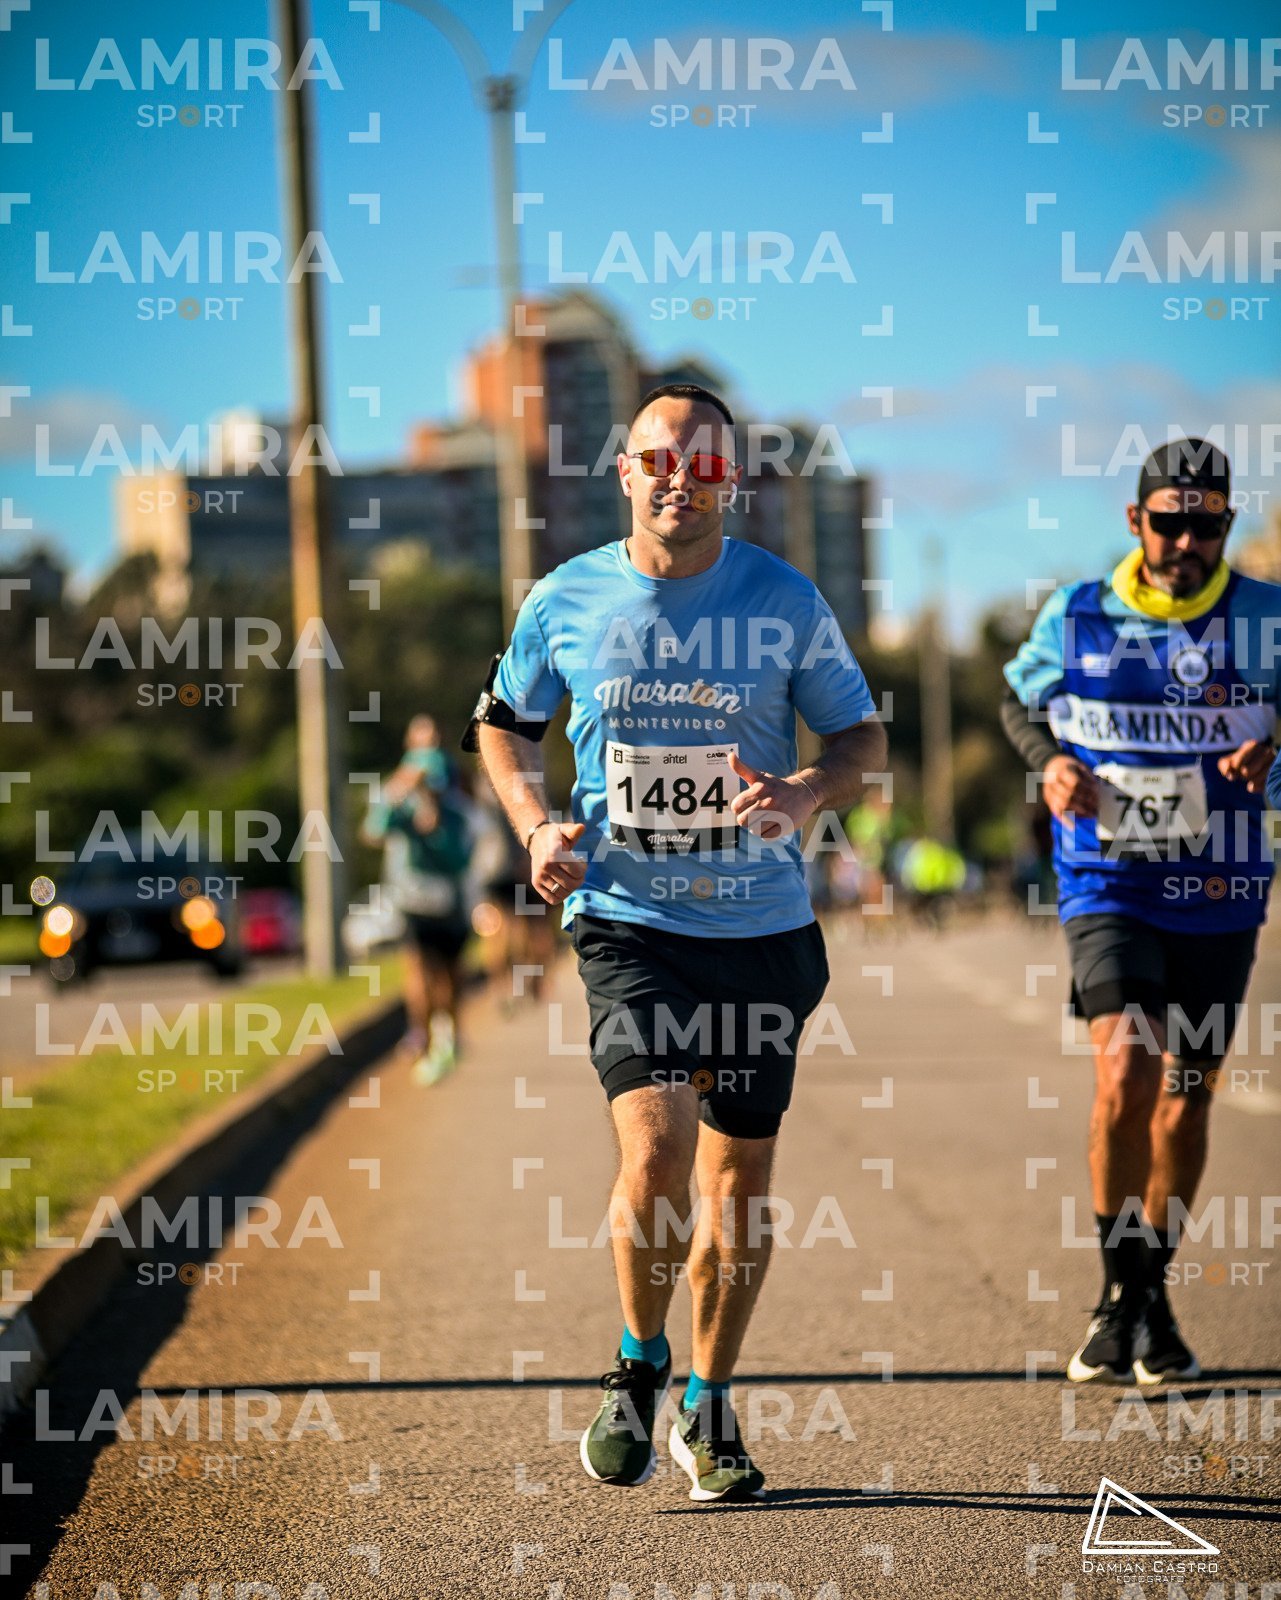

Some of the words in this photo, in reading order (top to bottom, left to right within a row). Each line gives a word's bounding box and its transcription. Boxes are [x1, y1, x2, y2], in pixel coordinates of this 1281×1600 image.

[594, 674, 742, 714] Maratón
[608, 717, 726, 731] MONTEVIDEO
[663, 754, 687, 764] antel
[617, 776, 728, 815] 1484
[1115, 794, 1183, 827] 767
[647, 833, 694, 845] Maratón
